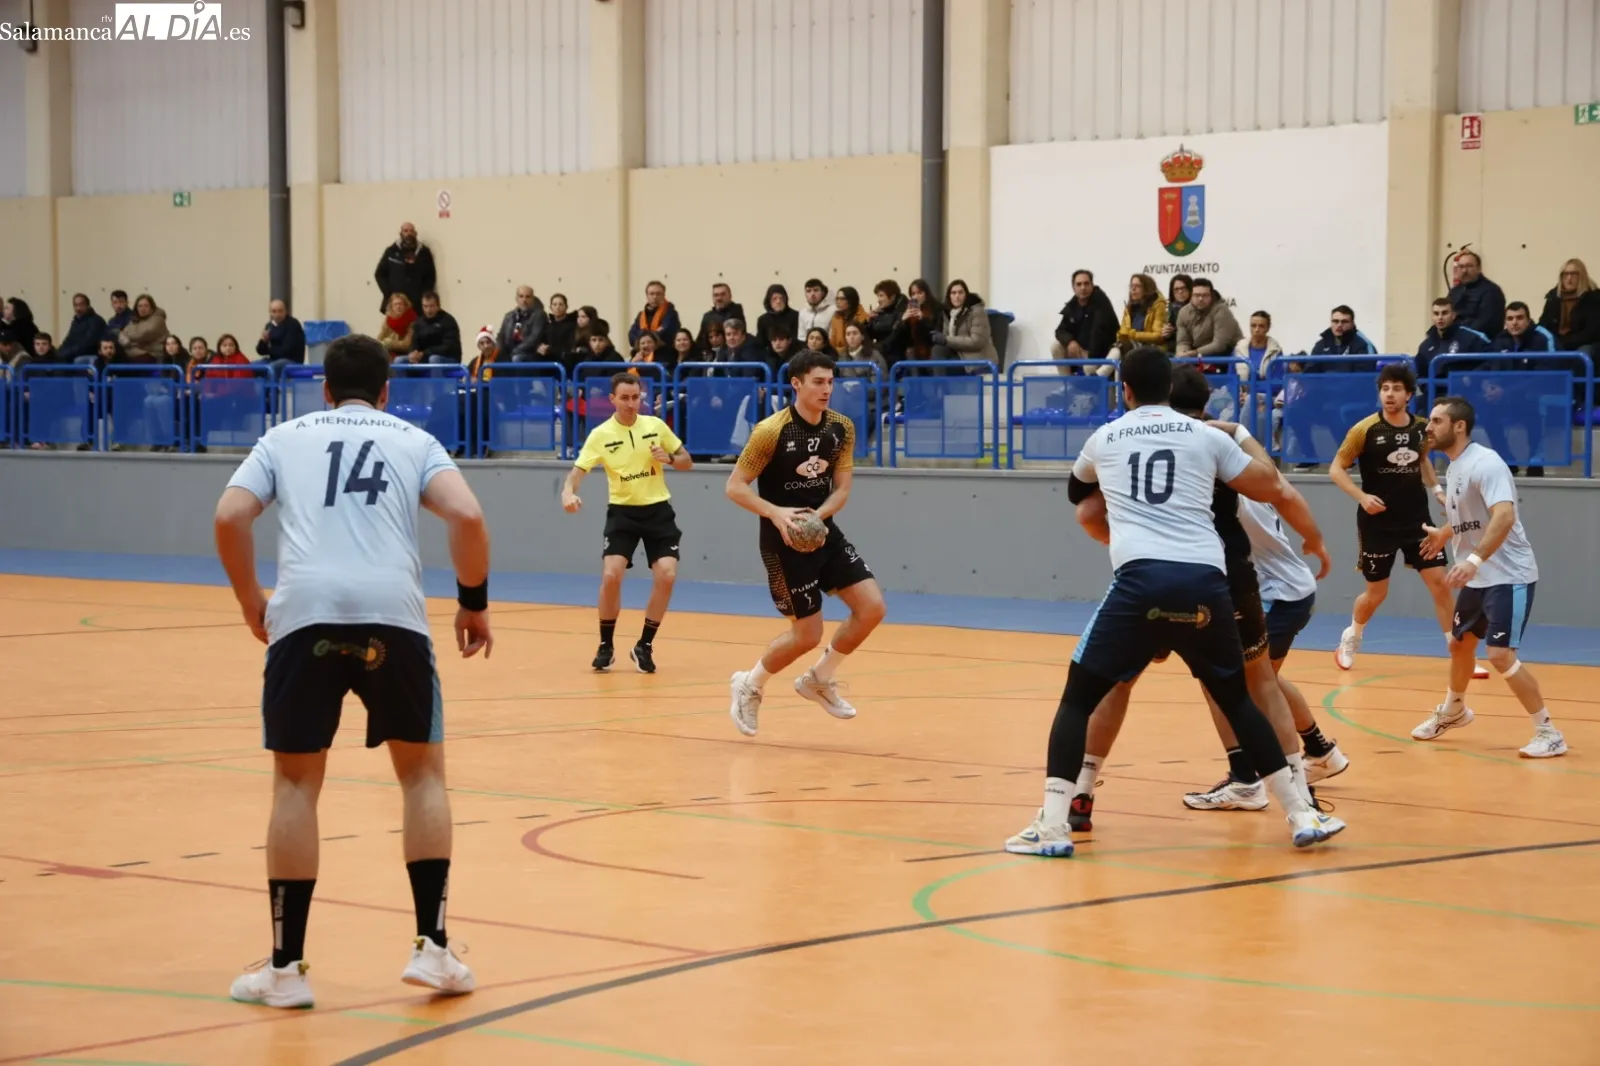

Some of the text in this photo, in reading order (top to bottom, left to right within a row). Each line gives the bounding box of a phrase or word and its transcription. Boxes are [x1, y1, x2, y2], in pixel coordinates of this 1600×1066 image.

[1142, 262, 1220, 275] AYUNTAMIENTO
[296, 420, 311, 430] A.
[1106, 422, 1194, 445] R. FRANQUEZA
[1395, 432, 1410, 446] 99
[807, 437, 821, 452] 27
[1396, 452, 1411, 461] CG
[806, 461, 820, 473] CG
[323, 440, 389, 508] 14
[620, 471, 650, 483] helvetia
[1127, 449, 1176, 505] 10
